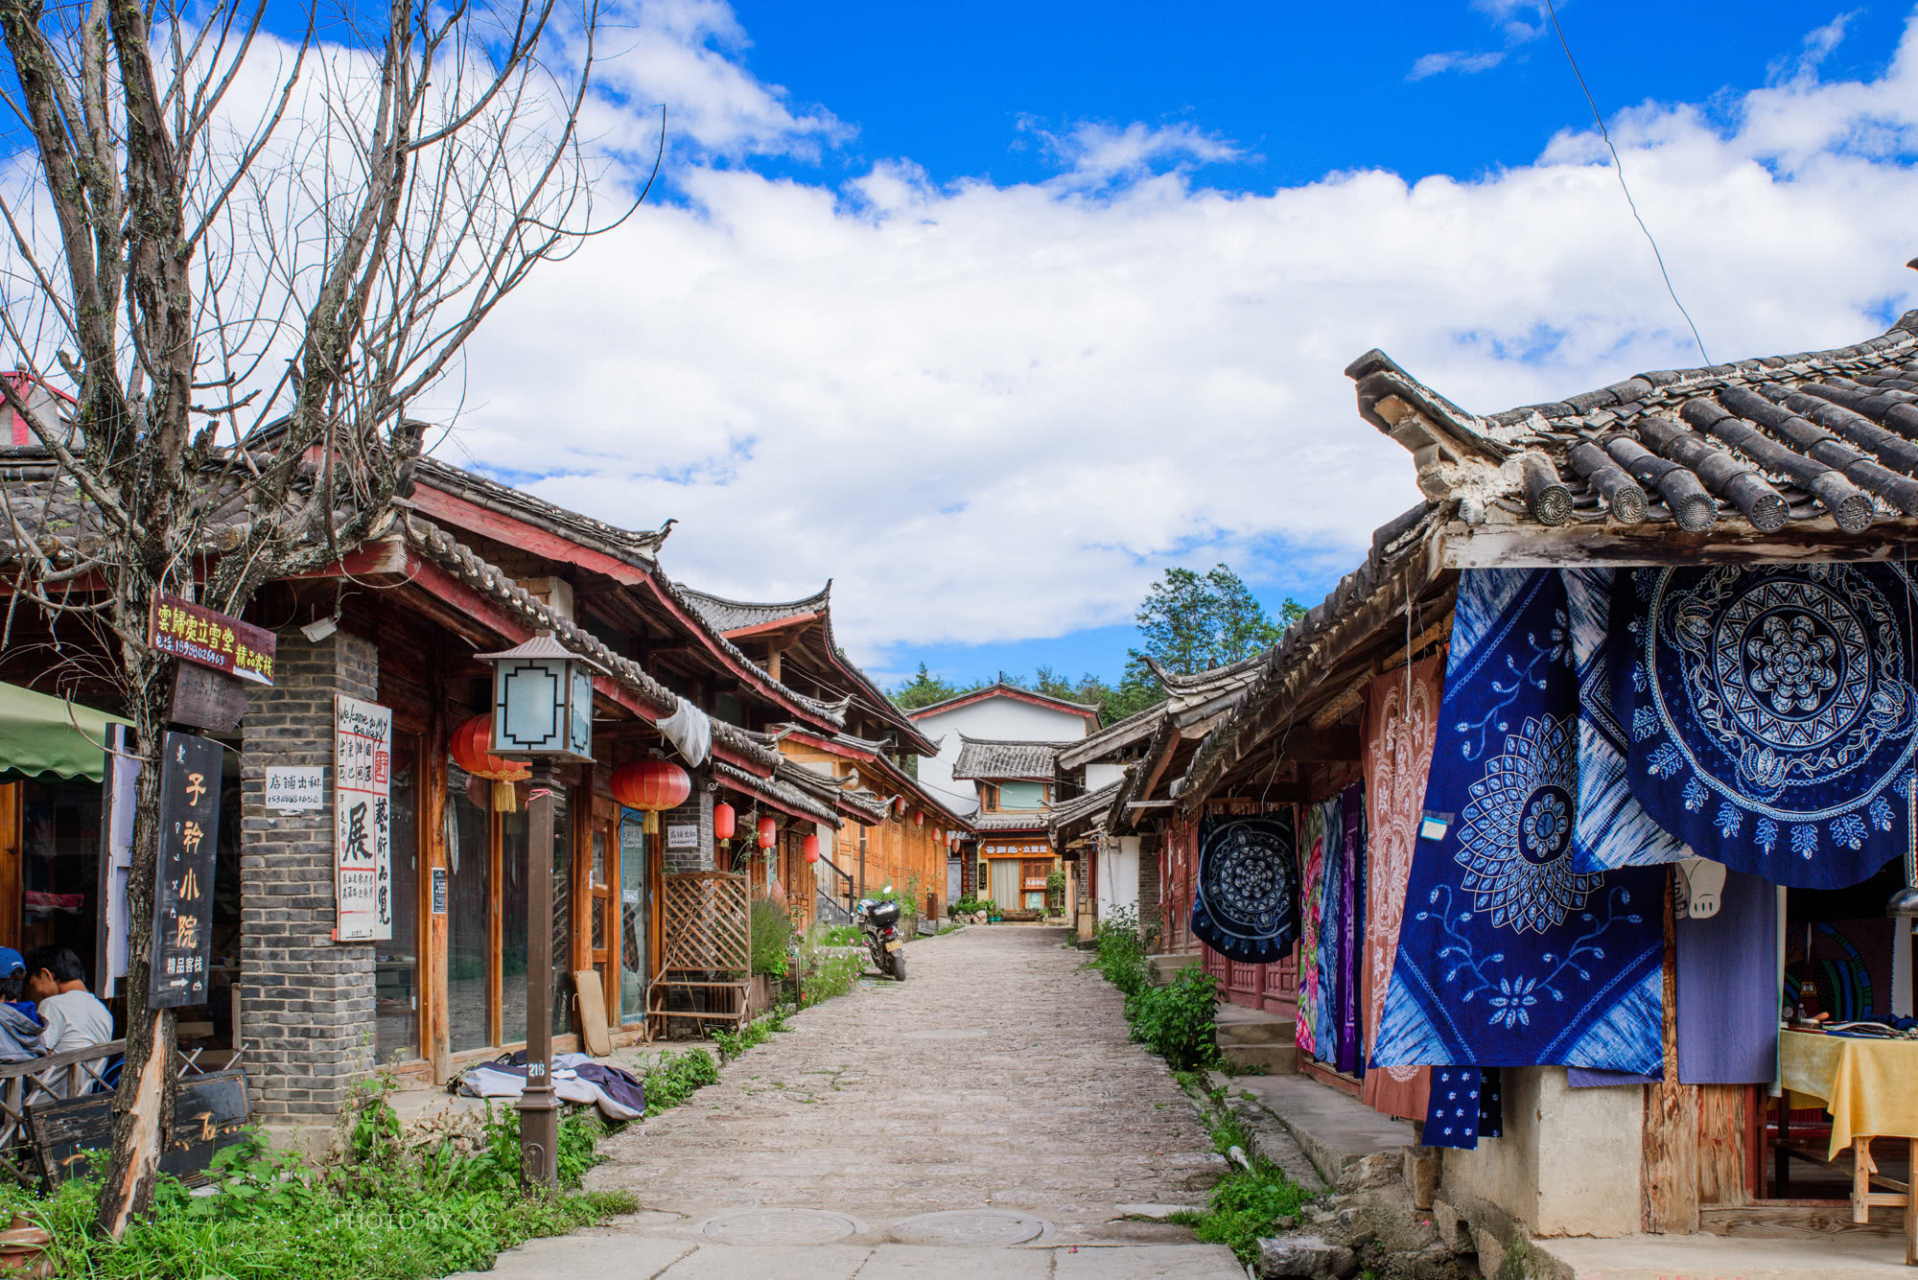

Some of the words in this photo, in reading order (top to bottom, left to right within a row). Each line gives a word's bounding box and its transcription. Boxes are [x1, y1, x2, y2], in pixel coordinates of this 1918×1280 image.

[235, 643, 273, 677] 精品客栈
[177, 773, 207, 949] 子衿小院
[166, 956, 203, 975] 精品客栈
